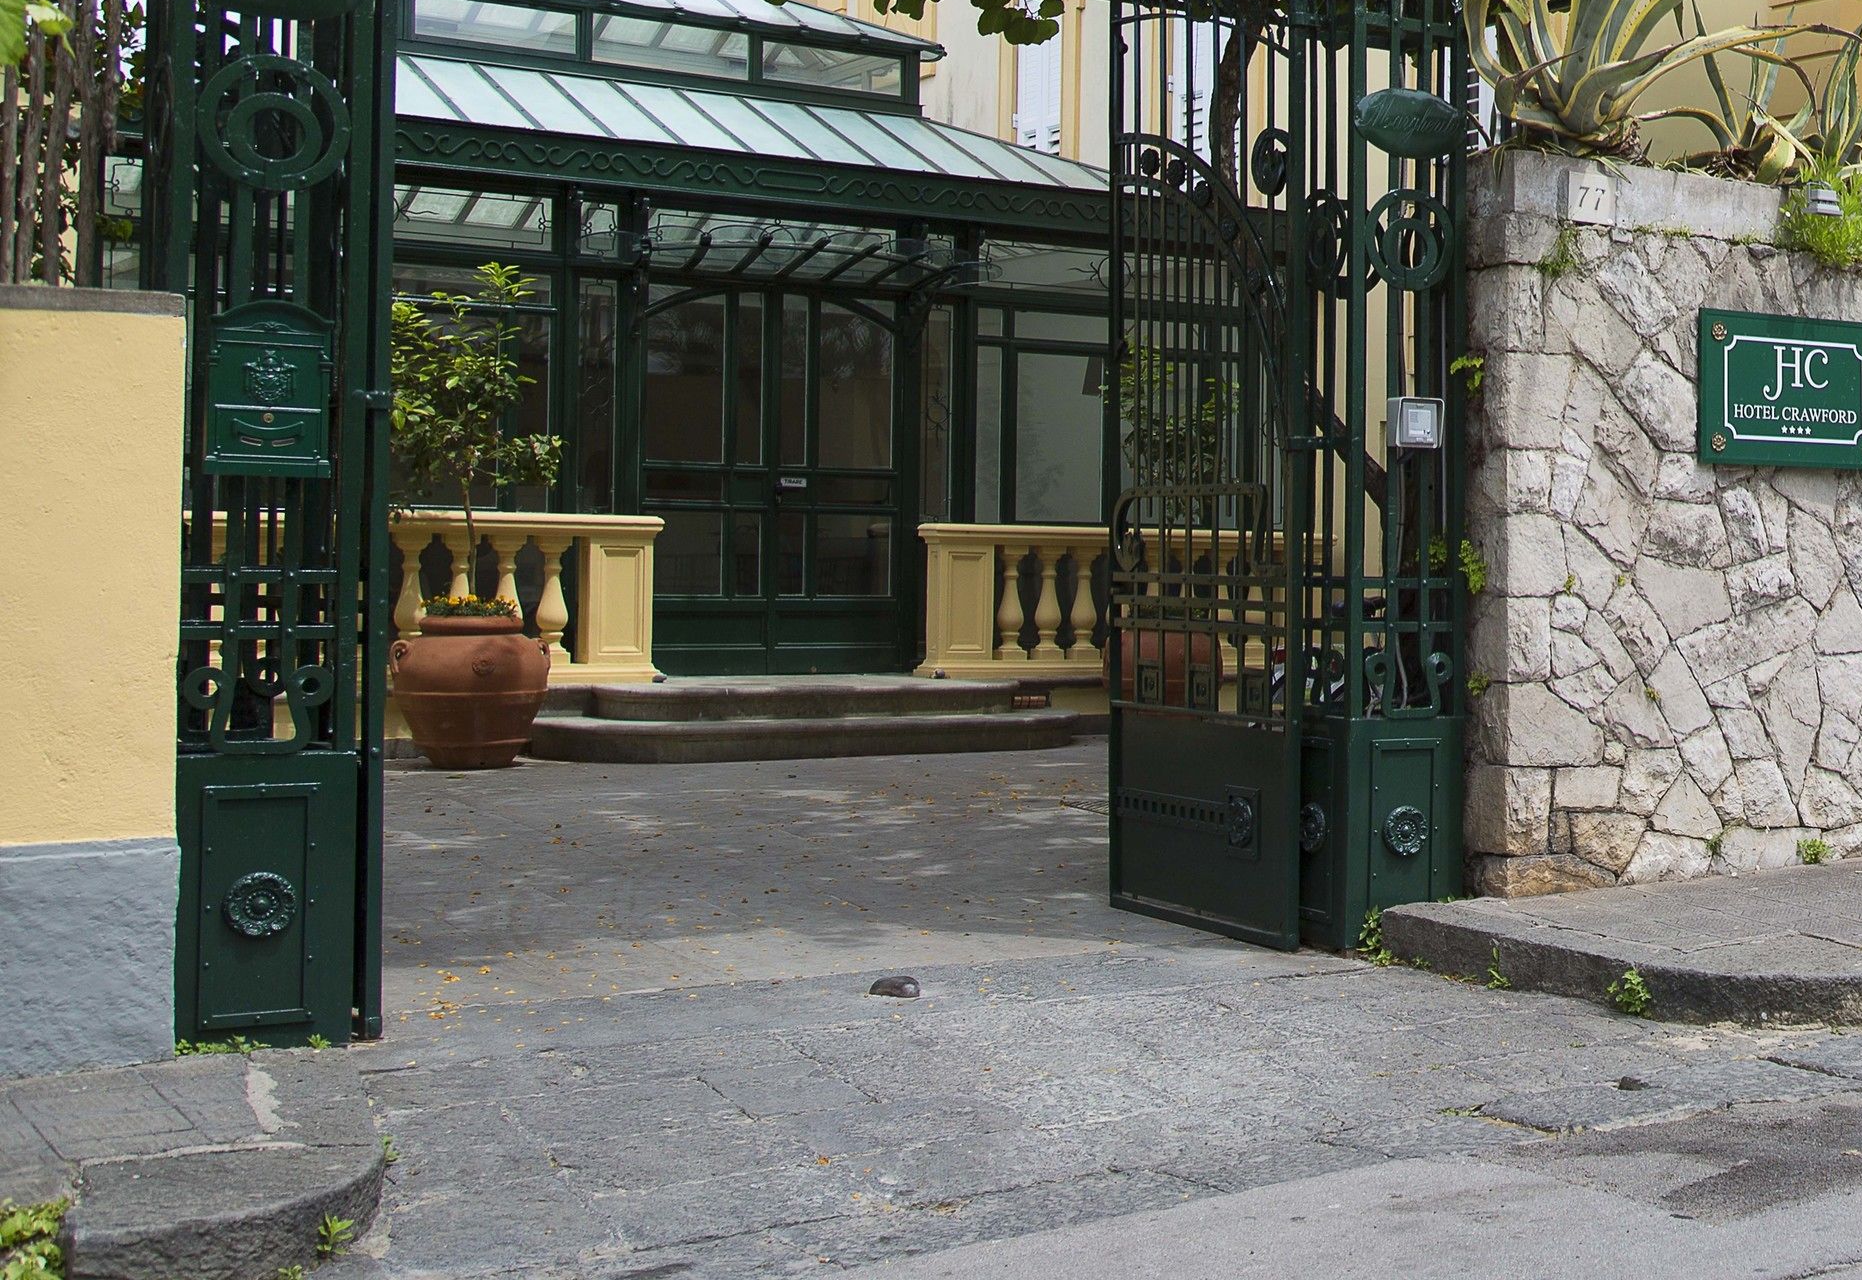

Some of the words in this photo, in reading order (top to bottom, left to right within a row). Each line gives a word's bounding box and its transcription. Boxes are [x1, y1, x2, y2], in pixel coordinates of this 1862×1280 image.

[1578, 186, 1606, 210] 77
[1733, 403, 1779, 420] HOTEL
[1781, 407, 1857, 424] CRAWFORD
